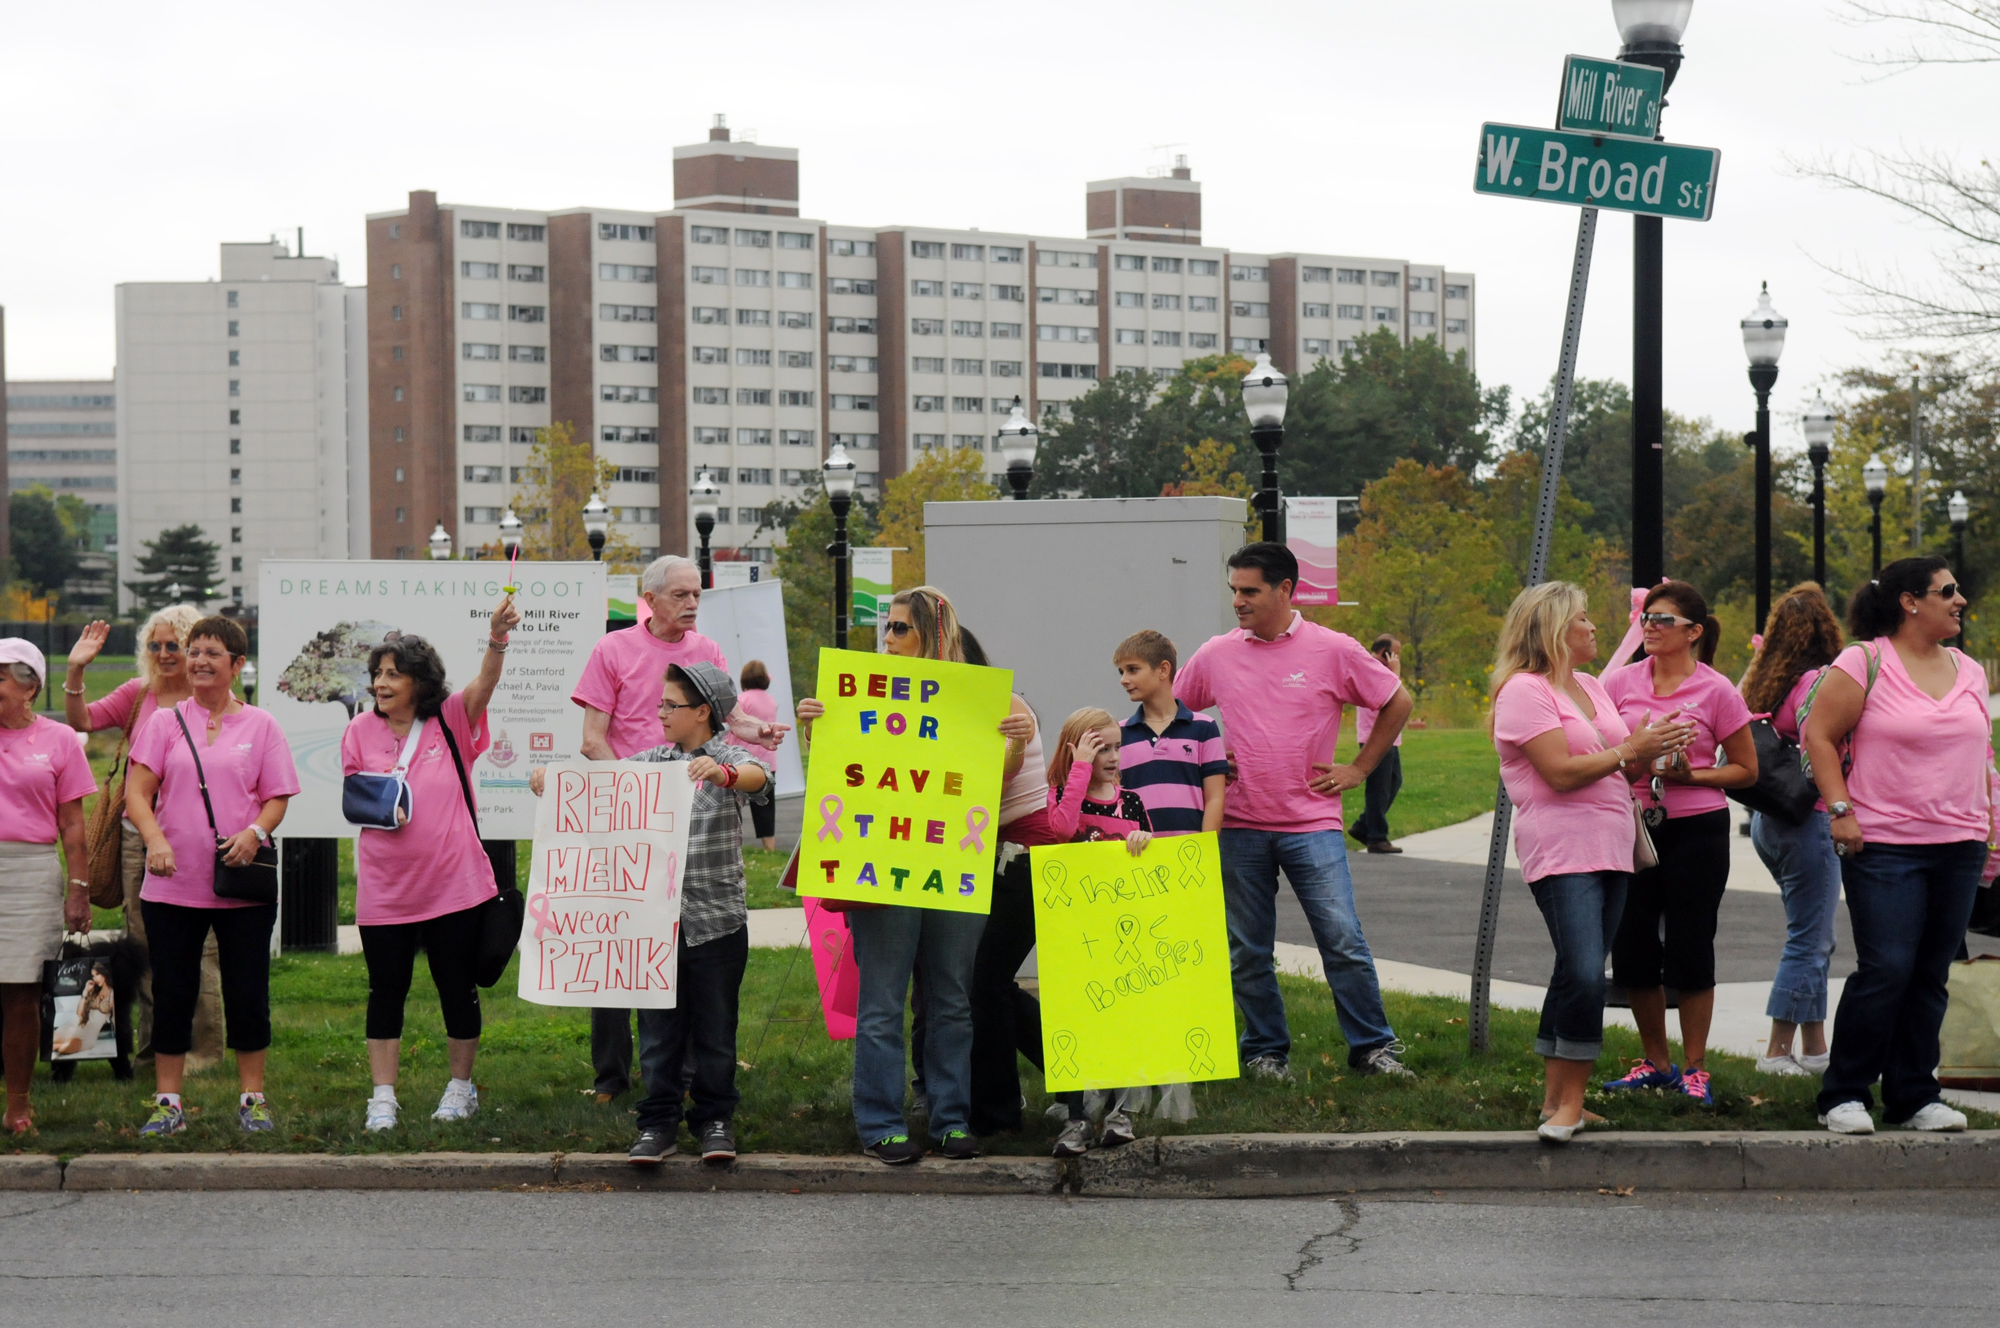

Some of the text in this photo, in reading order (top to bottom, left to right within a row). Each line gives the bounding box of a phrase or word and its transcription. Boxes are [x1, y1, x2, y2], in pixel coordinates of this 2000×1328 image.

[1566, 67, 1657, 129] Mill River St
[1487, 134, 1704, 209] W. Broad St
[280, 579, 585, 597] DREAMS TAKING ROOT
[524, 609, 545, 619] Mill
[549, 610, 581, 619] River
[522, 624, 534, 632] to
[538, 623, 560, 632] Life
[538, 648, 575, 656] Greenway
[506, 667, 565, 676] of Stamford
[495, 682, 560, 691] ichael A. Pavia
[511, 693, 535, 702] Mayor
[838, 673, 940, 703] BEEP
[508, 707, 564, 716] Redevelopment
[859, 710, 939, 741] FOR
[844, 763, 964, 797] SAVE
[494, 805, 514, 813] Park
[556, 770, 674, 834] REAL
[854, 814, 946, 845] THE
[545, 842, 651, 895] MEN
[1079, 864, 1170, 904] help
[551, 910, 630, 936] wear
